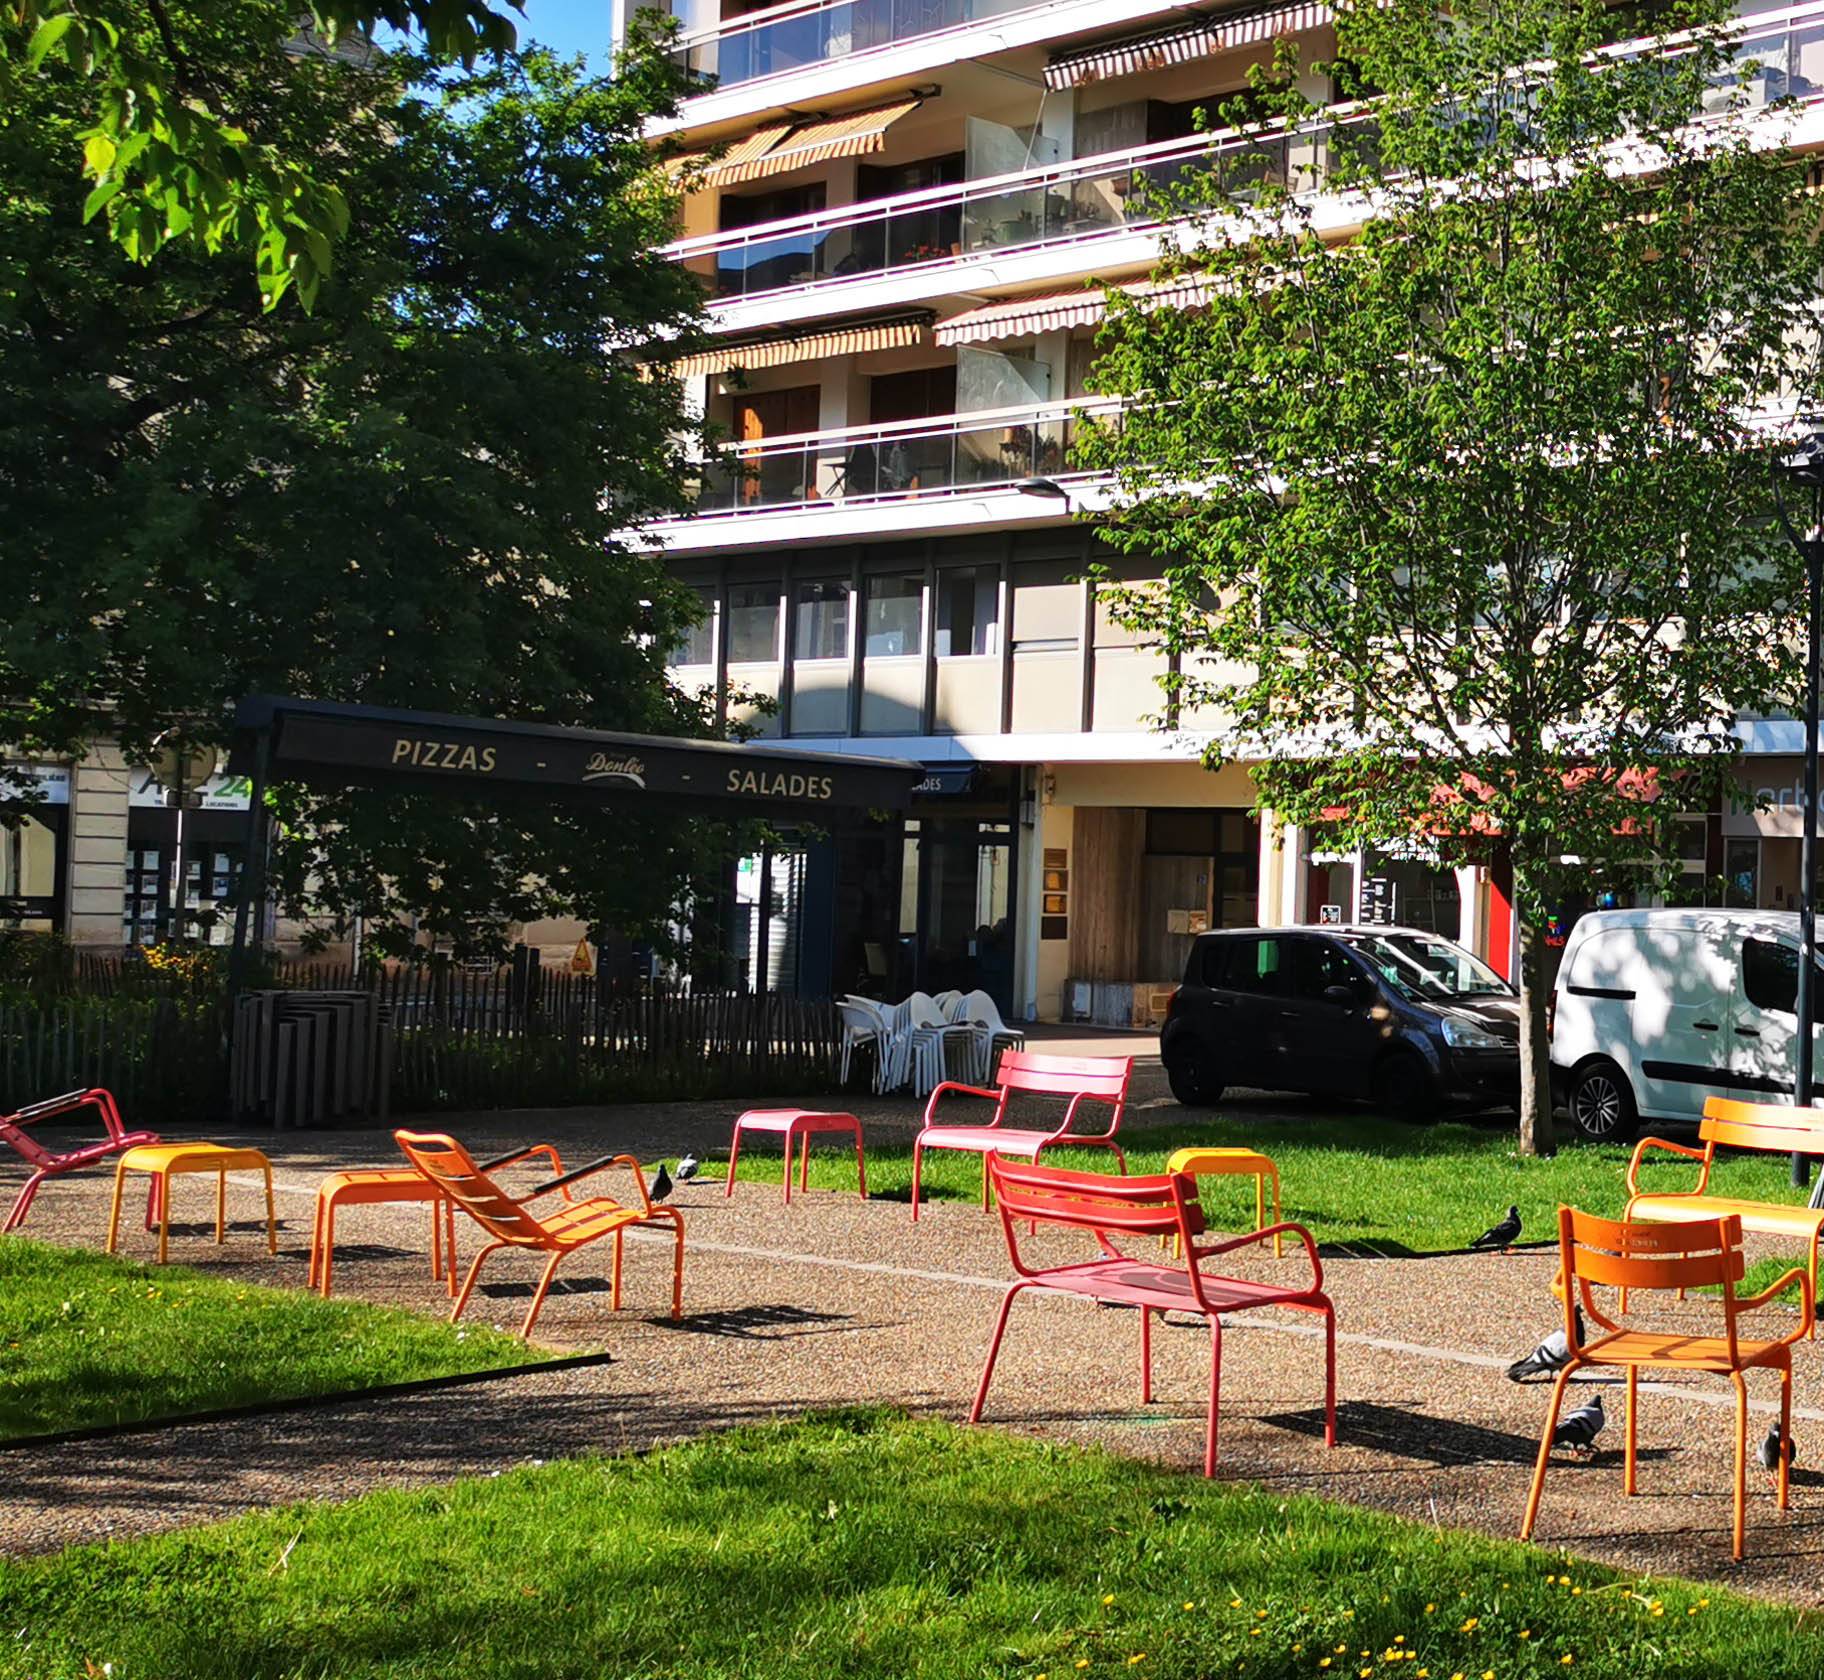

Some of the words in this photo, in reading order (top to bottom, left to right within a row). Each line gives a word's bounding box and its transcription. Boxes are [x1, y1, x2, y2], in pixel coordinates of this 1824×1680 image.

[213, 774, 252, 798] 24
[391, 739, 497, 772] PIZZAS
[727, 769, 833, 800] SALADES
